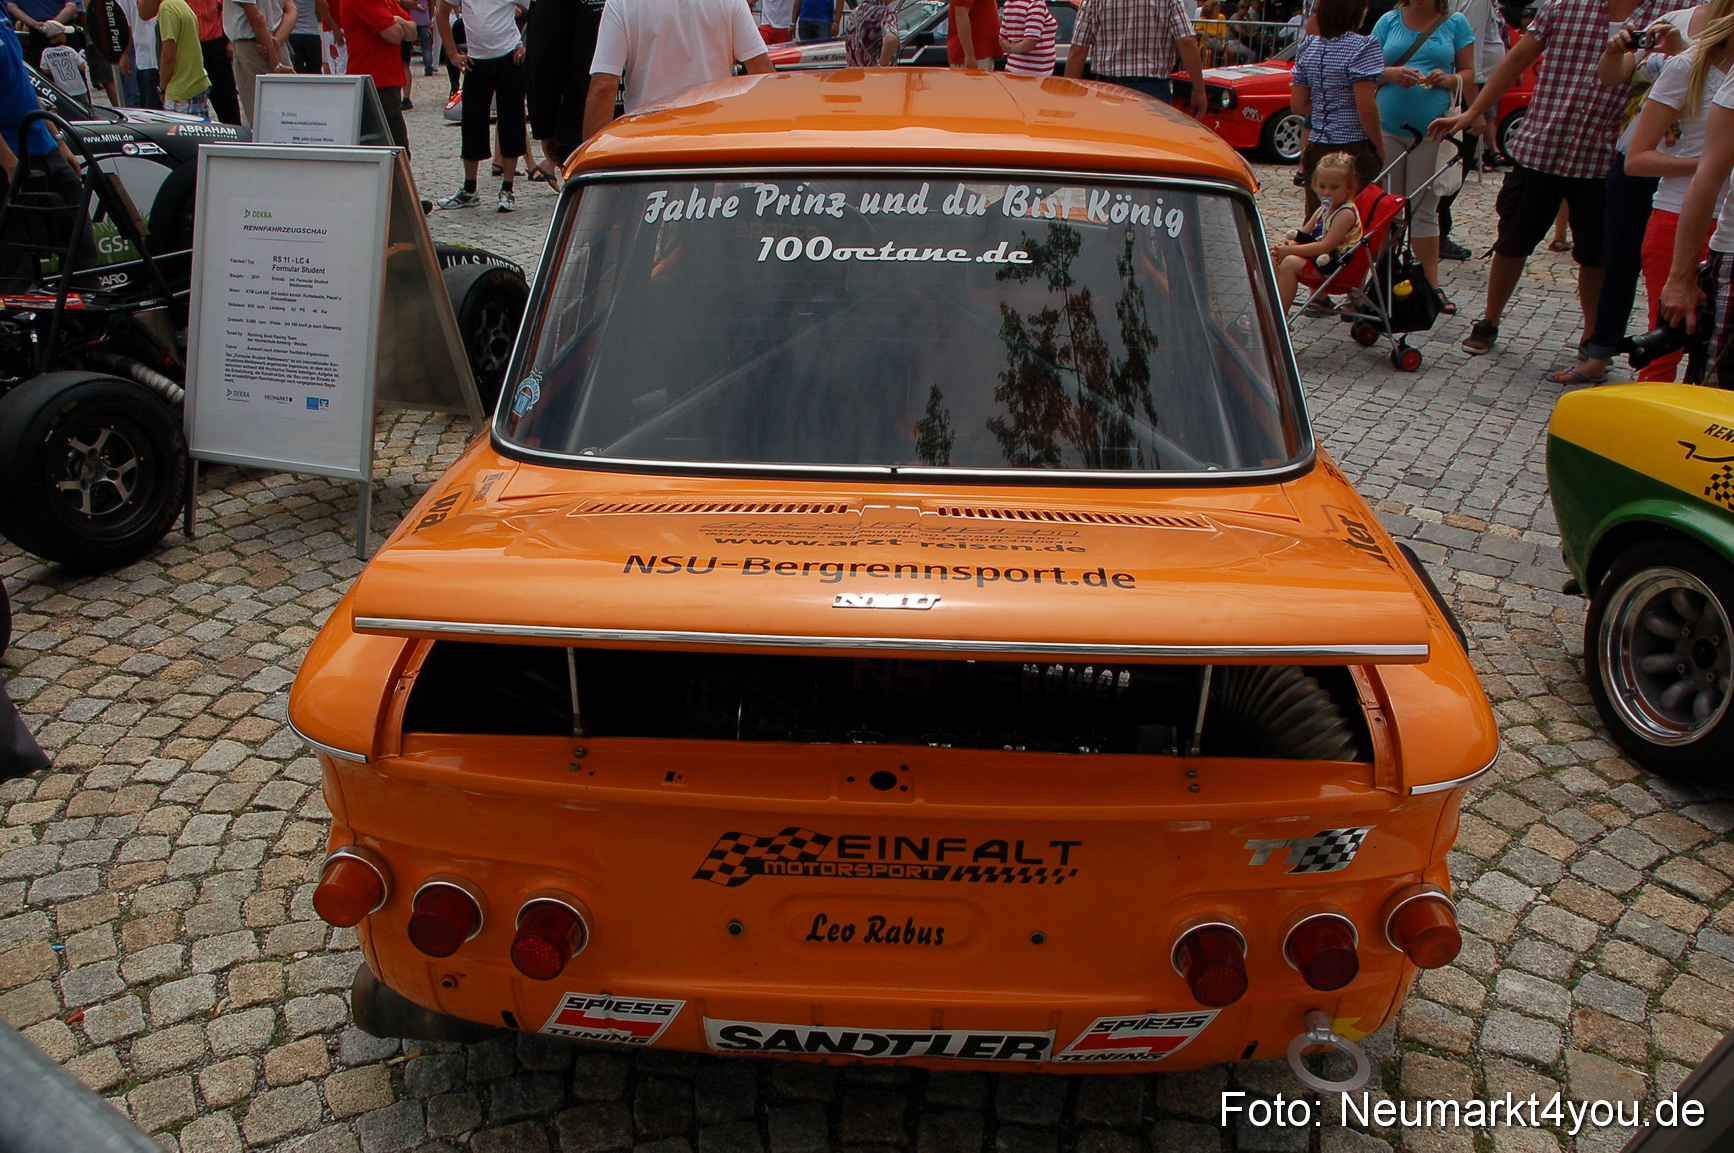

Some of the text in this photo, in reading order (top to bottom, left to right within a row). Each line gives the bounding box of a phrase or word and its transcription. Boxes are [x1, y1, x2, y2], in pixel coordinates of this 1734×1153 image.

[106, 1, 122, 52] Team Partl
[812, 54, 829, 62] Audi
[52, 58, 76, 81] 13
[29, 76, 58, 102] tl.de
[179, 125, 237, 135] ABRAHAM
[252, 210, 272, 219] DEKRA
[644, 182, 1184, 238] Fahre Prinz und du Bist König
[244, 224, 327, 235] RENNFAHRZEUGSCHAU
[758, 236, 1033, 264] 100octane.de
[272, 264, 325, 274] Formular Student
[98, 273, 128, 286] ARO
[714, 538, 1086, 552] www.arzt-reisen.de
[623, 554, 1136, 588] NSU-Bergrennsport.de
[836, 834, 1081, 865] EINFALT
[764, 860, 939, 879] MOTORSPORT
[806, 913, 944, 946] Leo Rabus
[564, 997, 676, 1016] SPIESS
[1090, 1014, 1210, 1032] SPIESS
[547, 1028, 651, 1045] TUNING
[716, 1025, 1050, 1060] SANDTLER
[1057, 1052, 1166, 1061] TUNING
